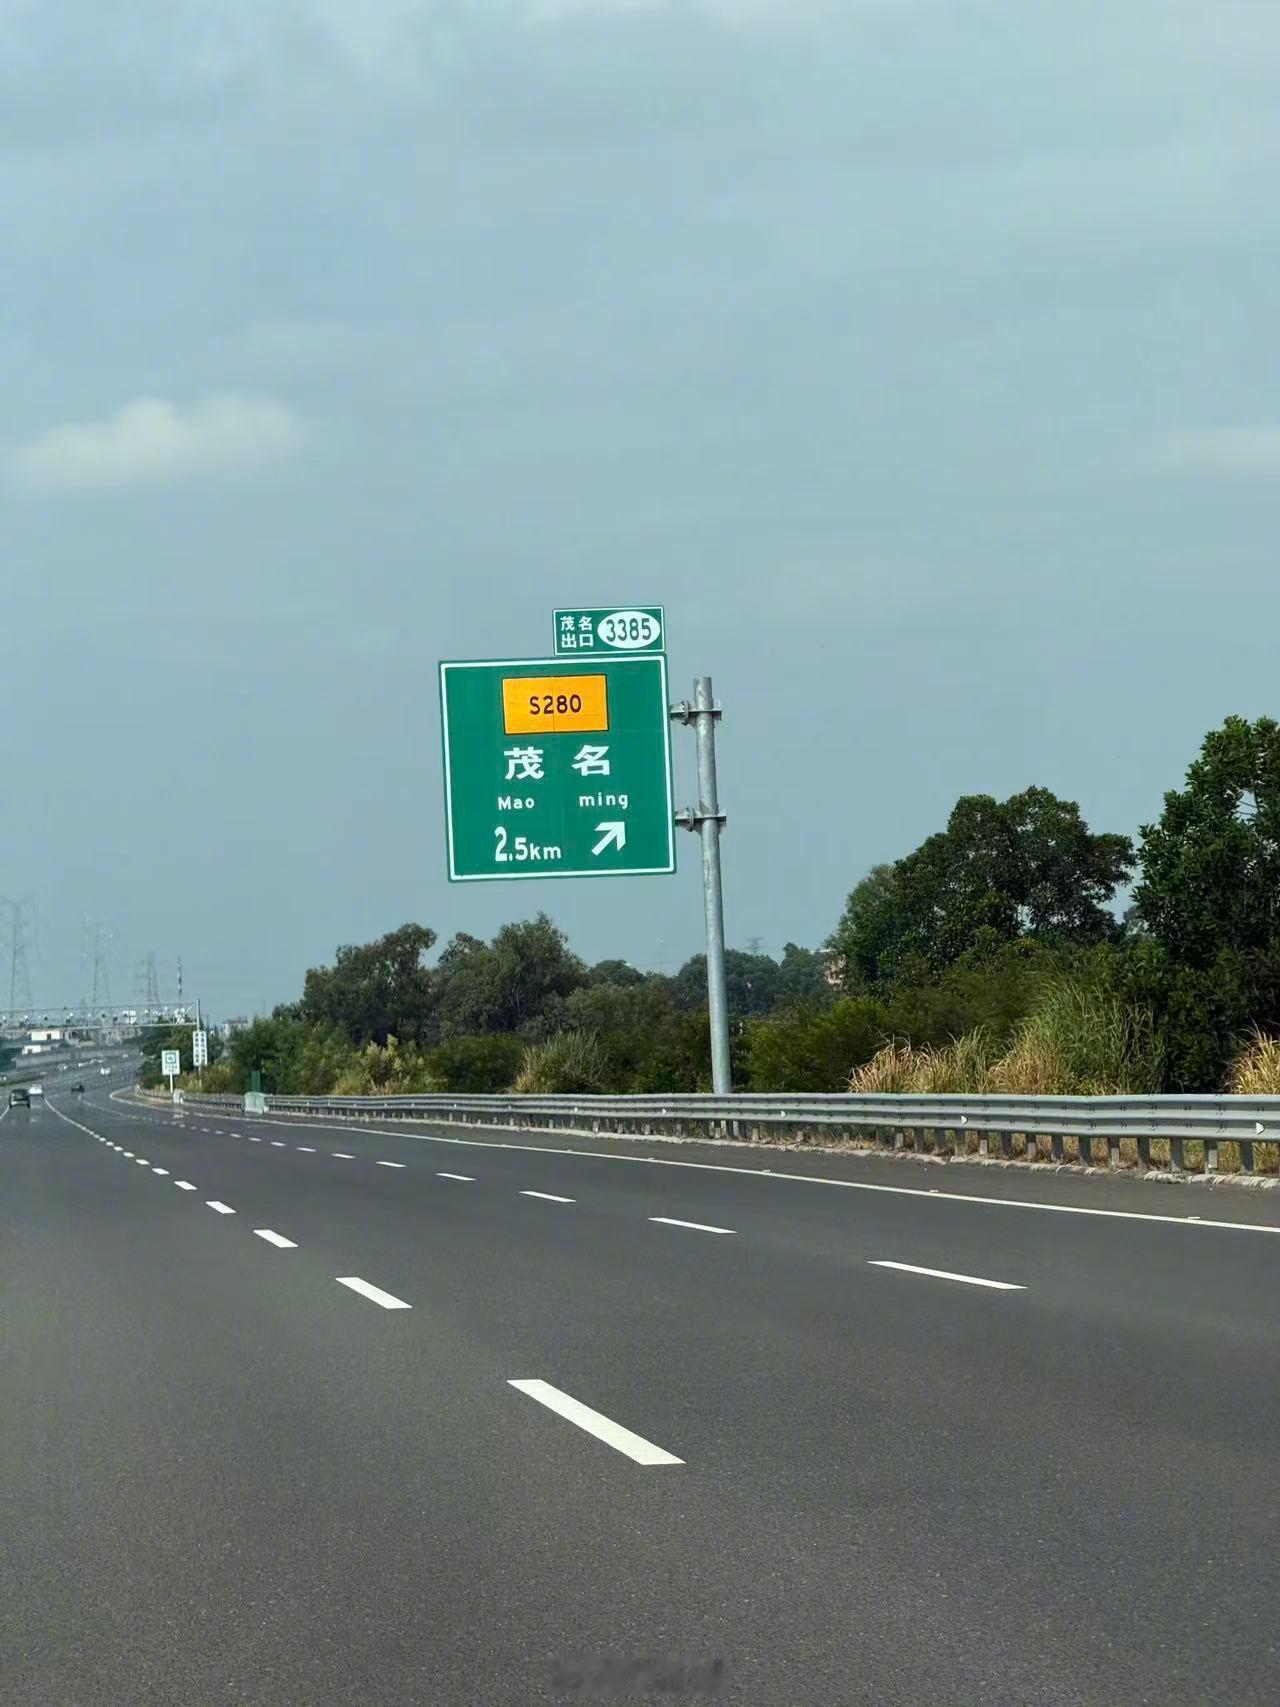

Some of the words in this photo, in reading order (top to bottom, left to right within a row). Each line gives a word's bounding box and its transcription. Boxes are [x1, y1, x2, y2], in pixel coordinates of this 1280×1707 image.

[560, 616, 593, 632] 茂名
[605, 617, 652, 642] 3385
[561, 633, 594, 648] 出口
[529, 693, 582, 715] S280
[503, 744, 611, 780] 茂名
[497, 796, 535, 810] Mao
[579, 792, 629, 810] ming
[494, 826, 562, 862] 2.5km
